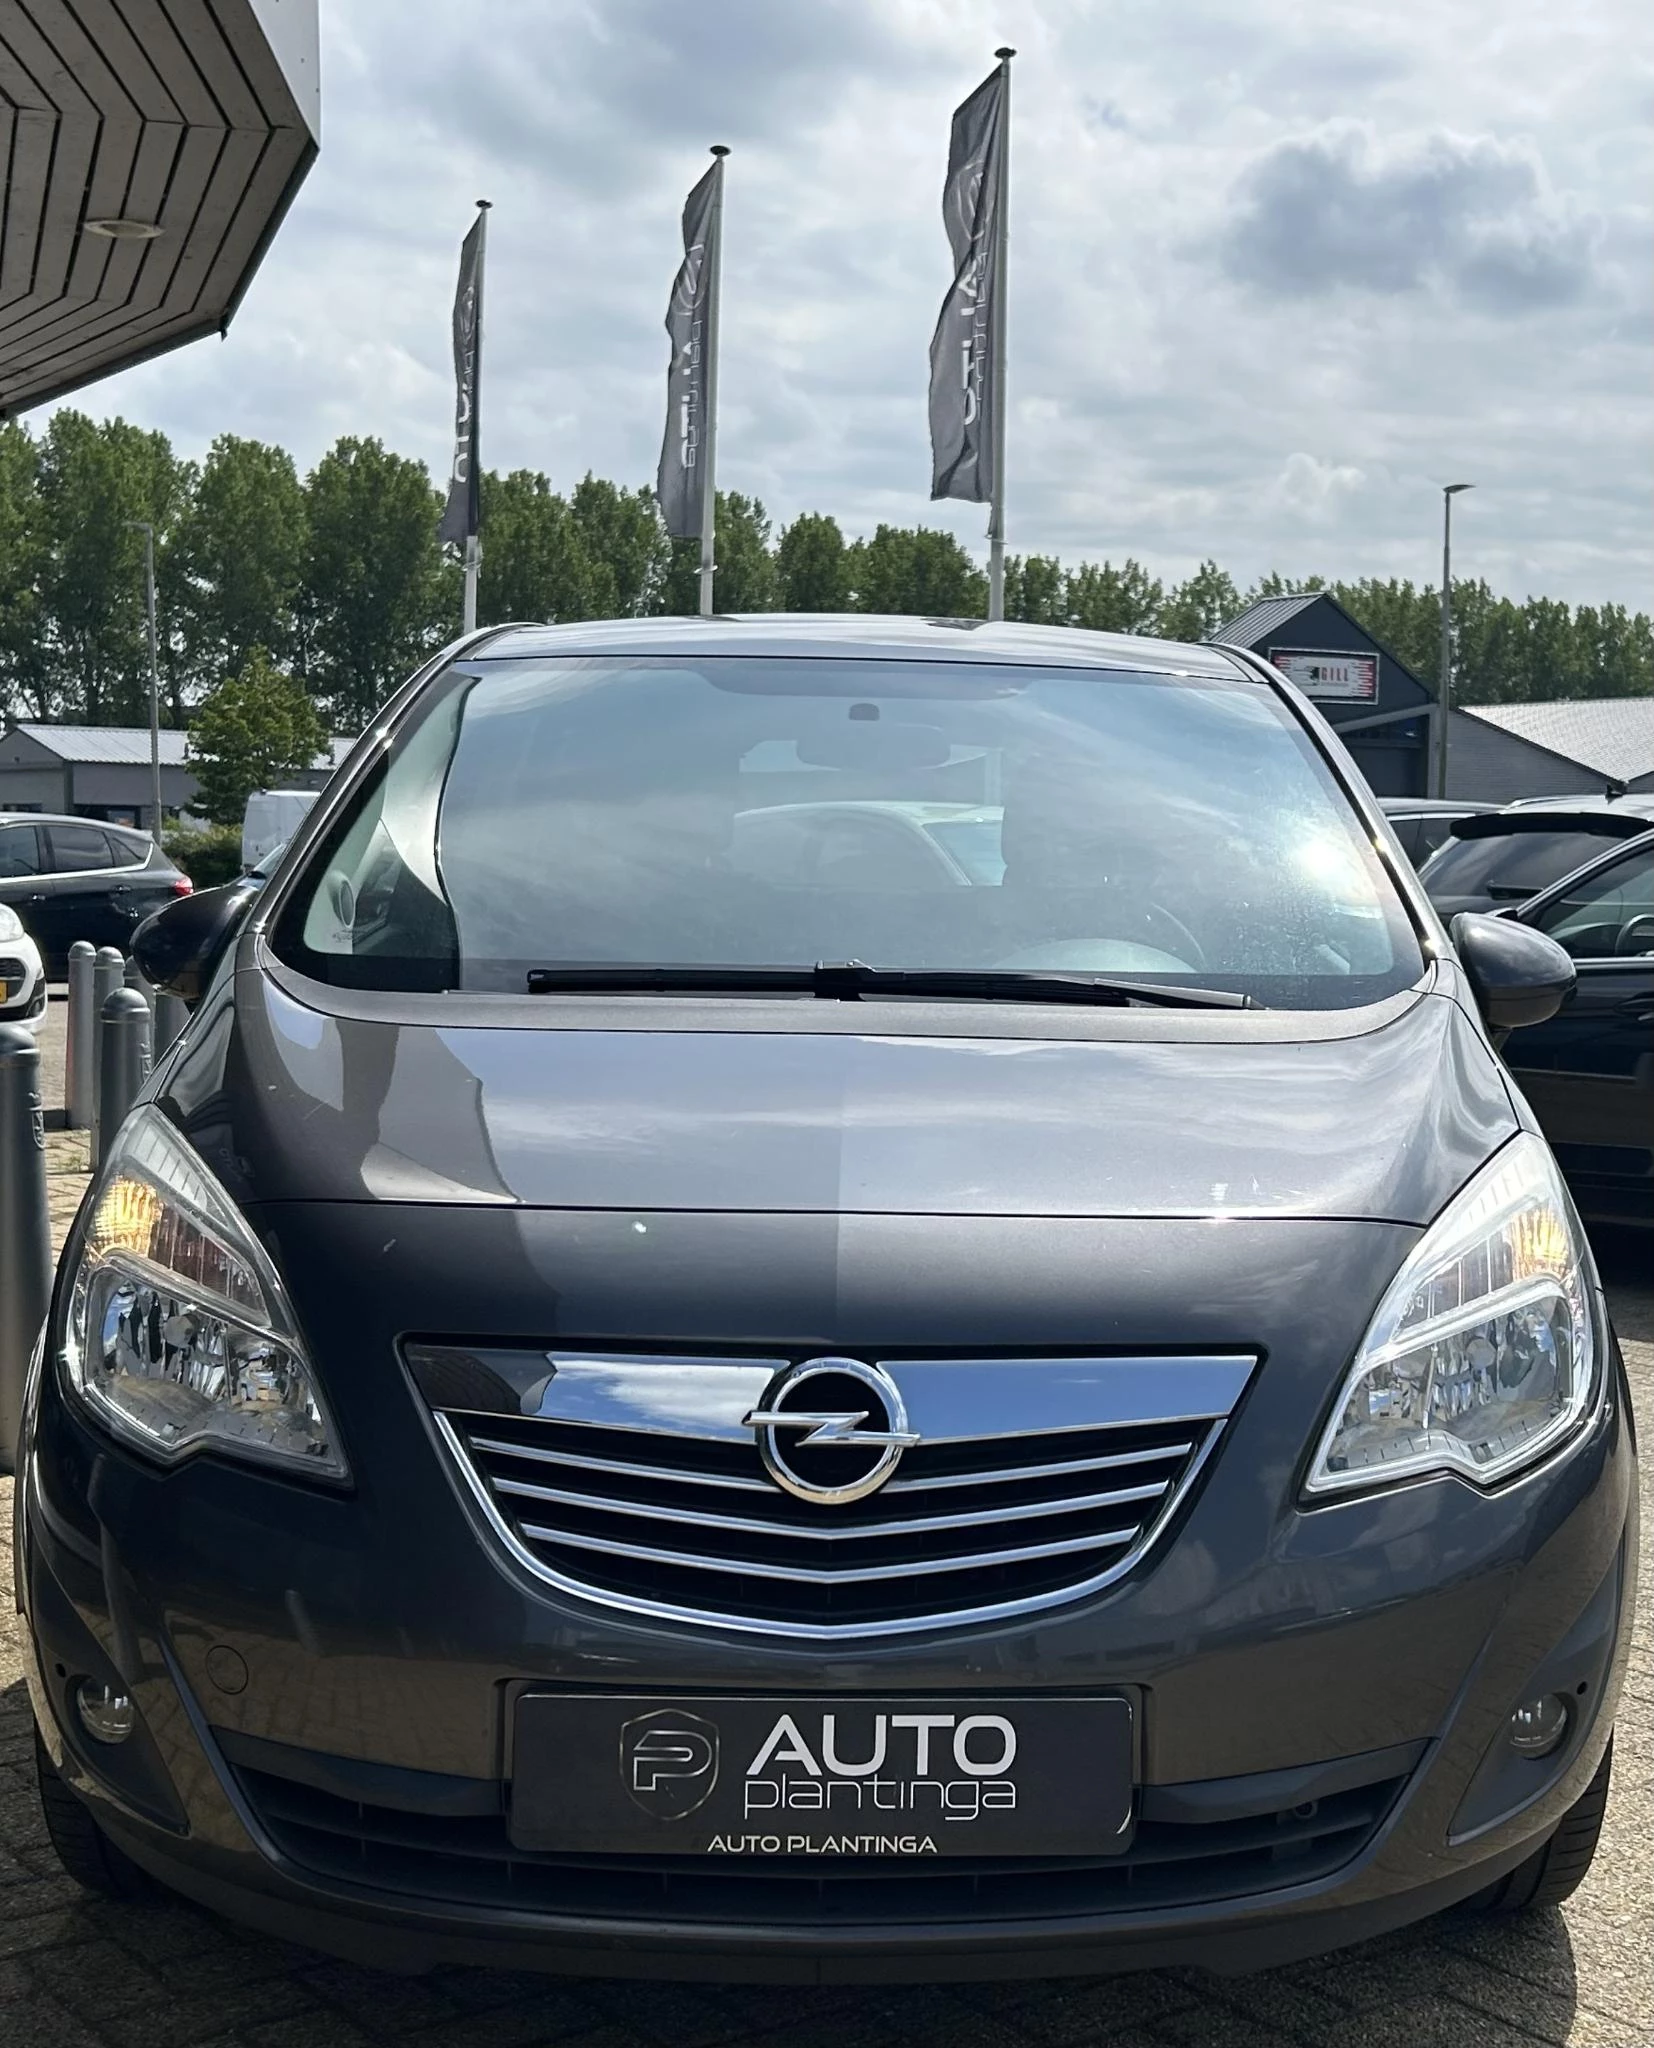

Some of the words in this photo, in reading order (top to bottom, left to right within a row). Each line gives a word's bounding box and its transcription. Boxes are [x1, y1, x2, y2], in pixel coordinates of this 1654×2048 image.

[745, 1714, 1017, 1777] AUTO
[744, 1773, 1017, 1821] plantinga
[707, 1834, 781, 1854] AUTO
[787, 1835, 938, 1854] PLANTINGA
